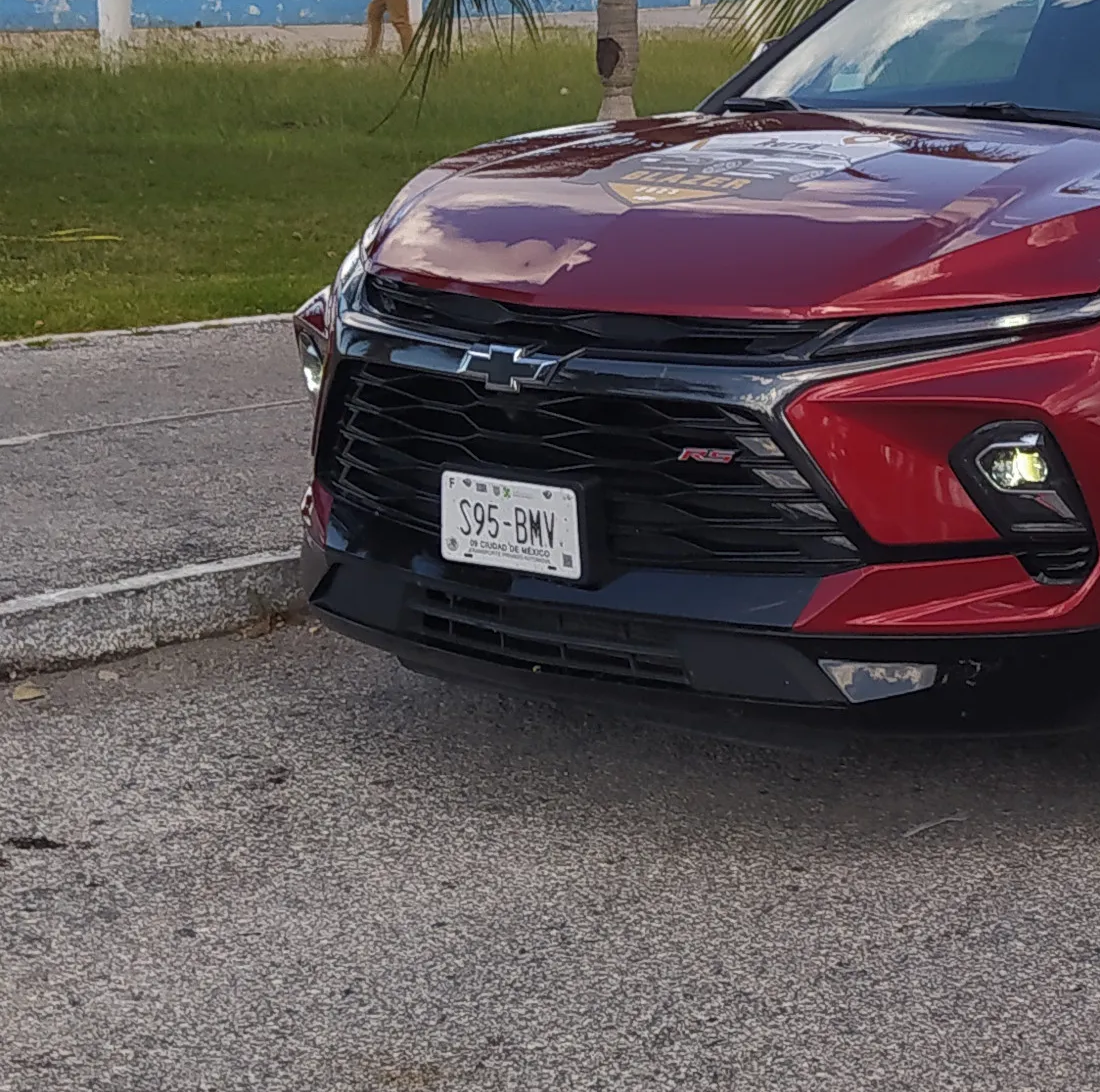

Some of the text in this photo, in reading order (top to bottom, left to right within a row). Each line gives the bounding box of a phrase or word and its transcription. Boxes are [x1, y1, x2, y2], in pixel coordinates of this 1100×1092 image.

[620, 170, 751, 190] BLAZER
[677, 447, 736, 464] RS
[459, 498, 555, 549] S95-BMV
[480, 540, 508, 552] CIUDAD
[509, 544, 520, 554] DE
[521, 546, 551, 558] MÉXICO
